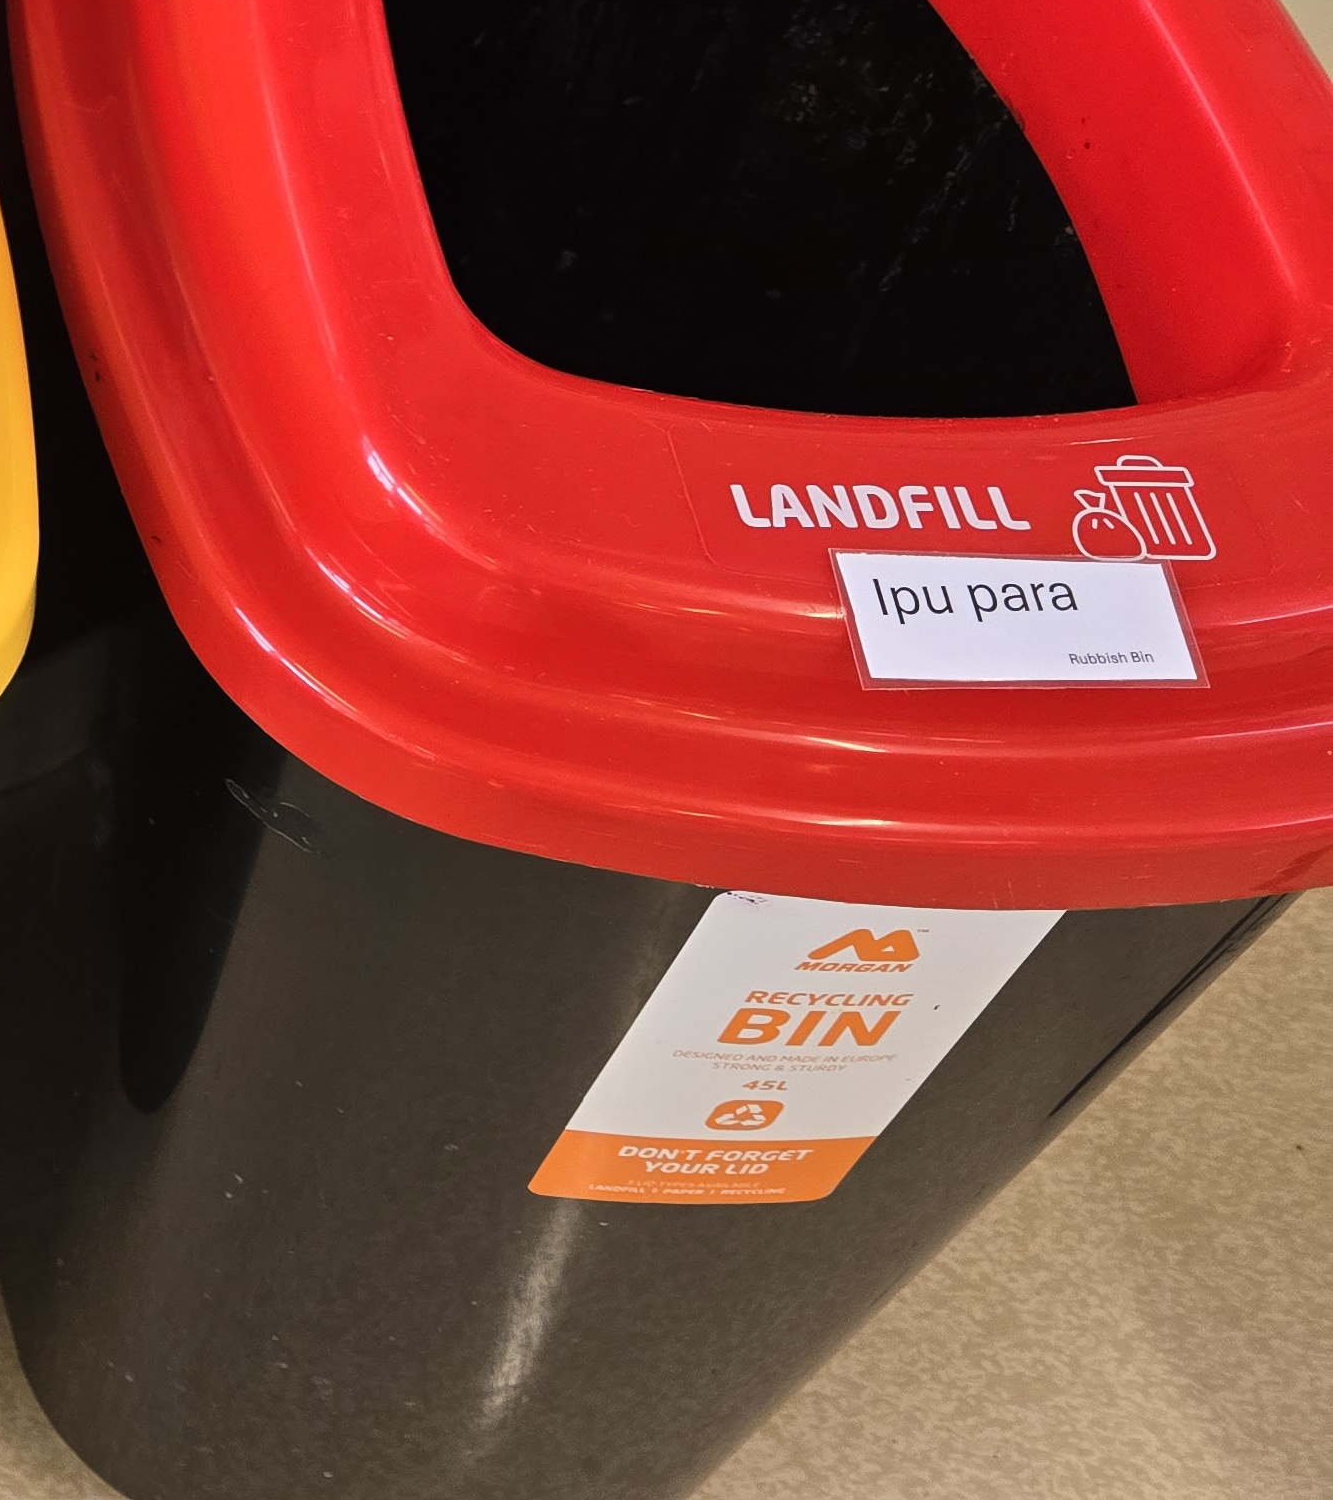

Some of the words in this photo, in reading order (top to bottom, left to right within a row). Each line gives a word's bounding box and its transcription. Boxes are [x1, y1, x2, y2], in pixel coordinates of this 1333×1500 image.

[730, 484, 1031, 530] LANDFILL
[873, 579, 953, 624] Ipu
[967, 583, 1078, 622] para
[1069, 653, 1128, 664] Rubbish
[1130, 651, 1154, 662] Bin
[795, 962, 913, 972] MORGAN
[745, 991, 914, 1006] RECYCLING
[718, 1008, 901, 1046] BIN
[743, 1080, 787, 1090] 45L
[618, 1146, 701, 1161] DON'T
[704, 1148, 814, 1162] FORGET
[645, 1161, 719, 1174] YOUR
[724, 1161, 769, 1174] LID
